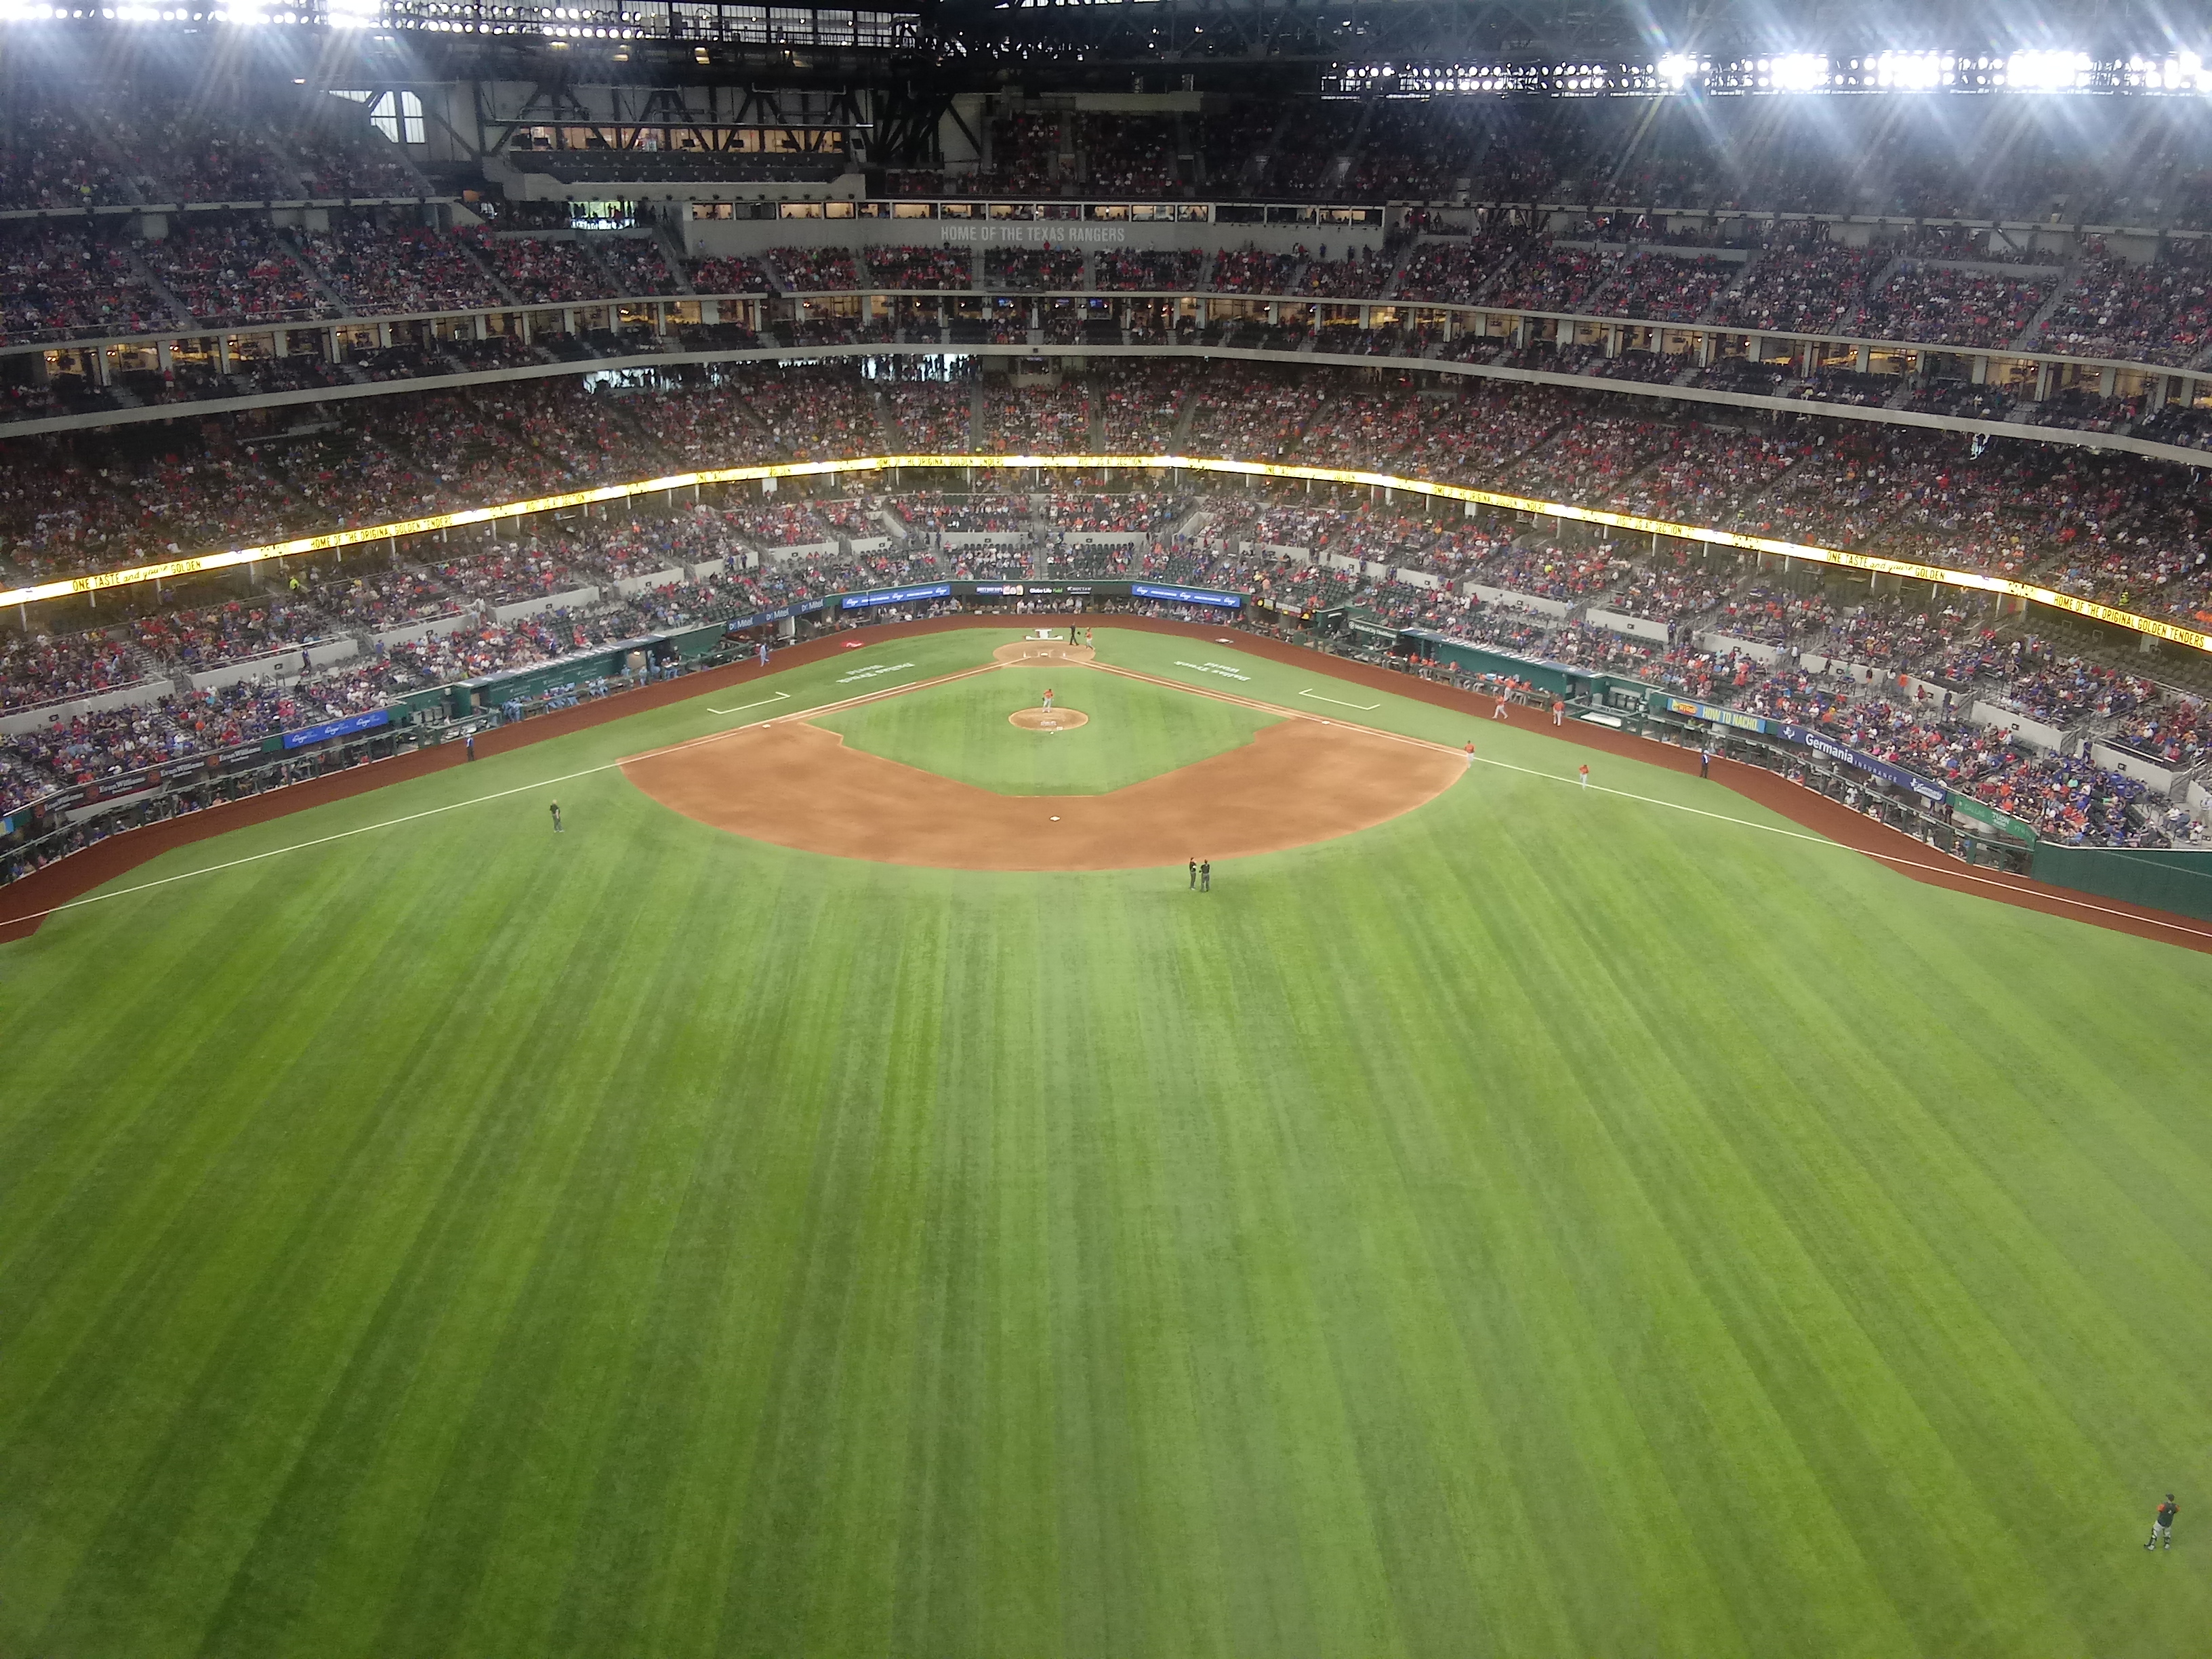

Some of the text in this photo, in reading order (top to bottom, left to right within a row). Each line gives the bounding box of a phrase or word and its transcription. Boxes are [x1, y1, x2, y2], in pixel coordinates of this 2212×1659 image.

[941, 226, 1125, 242] HOME OF THE TEXAS RANGERS
[394, 522, 420, 534] GOLDEN
[73, 578, 90, 592] ONE
[94, 573, 119, 588] TASTE
[123, 571, 140, 581] and
[171, 560, 201, 574] GOLDEN
[1826, 551, 1842, 563] ONE
[1845, 553, 1868, 568] TASTE
[1915, 567, 1945, 581] GOLDEN
[2053, 595, 2205, 648] HOME OF THE ORIGINAL GOLDEN TENDERS
[1702, 706, 1721, 721] HOW
[1721, 710, 1731, 724] TO
[1805, 733, 1898, 783] Germania INSURANCE
